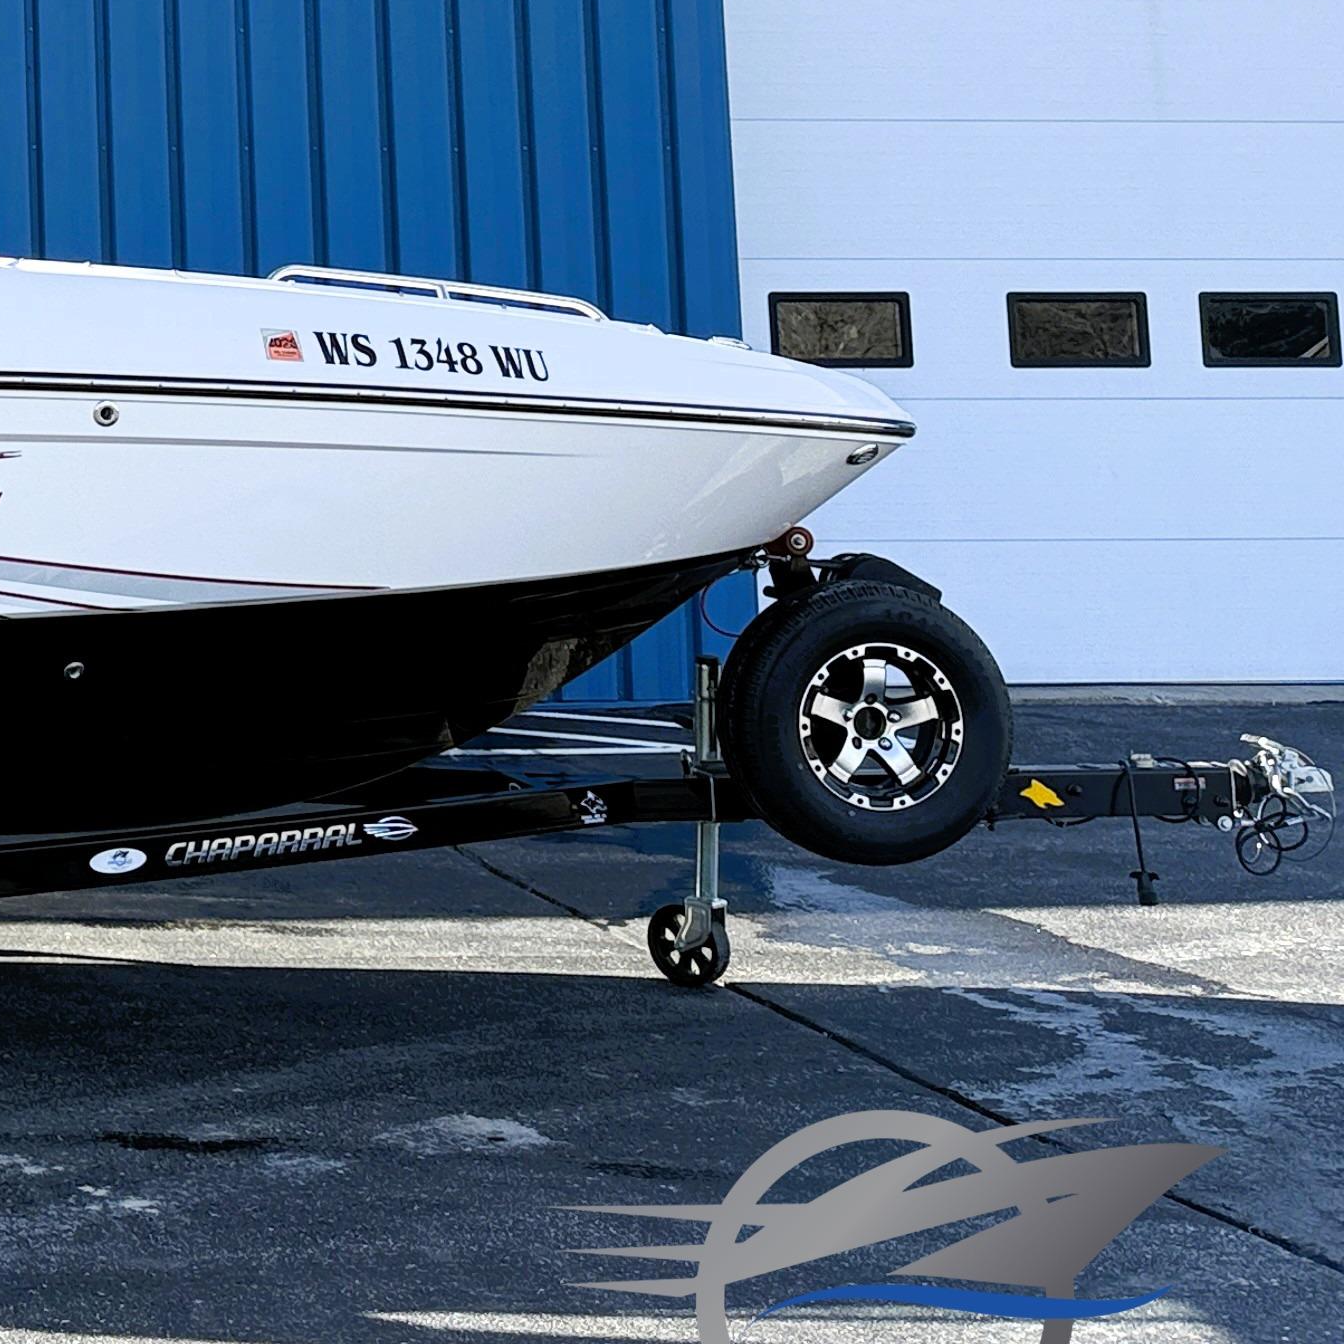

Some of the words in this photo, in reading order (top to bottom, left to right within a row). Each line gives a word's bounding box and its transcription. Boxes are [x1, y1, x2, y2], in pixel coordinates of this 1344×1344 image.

[313, 331, 377, 367] WS
[389, 337, 483, 375] 1348
[488, 344, 550, 382] WU
[164, 822, 363, 867] CHAPARRAL
